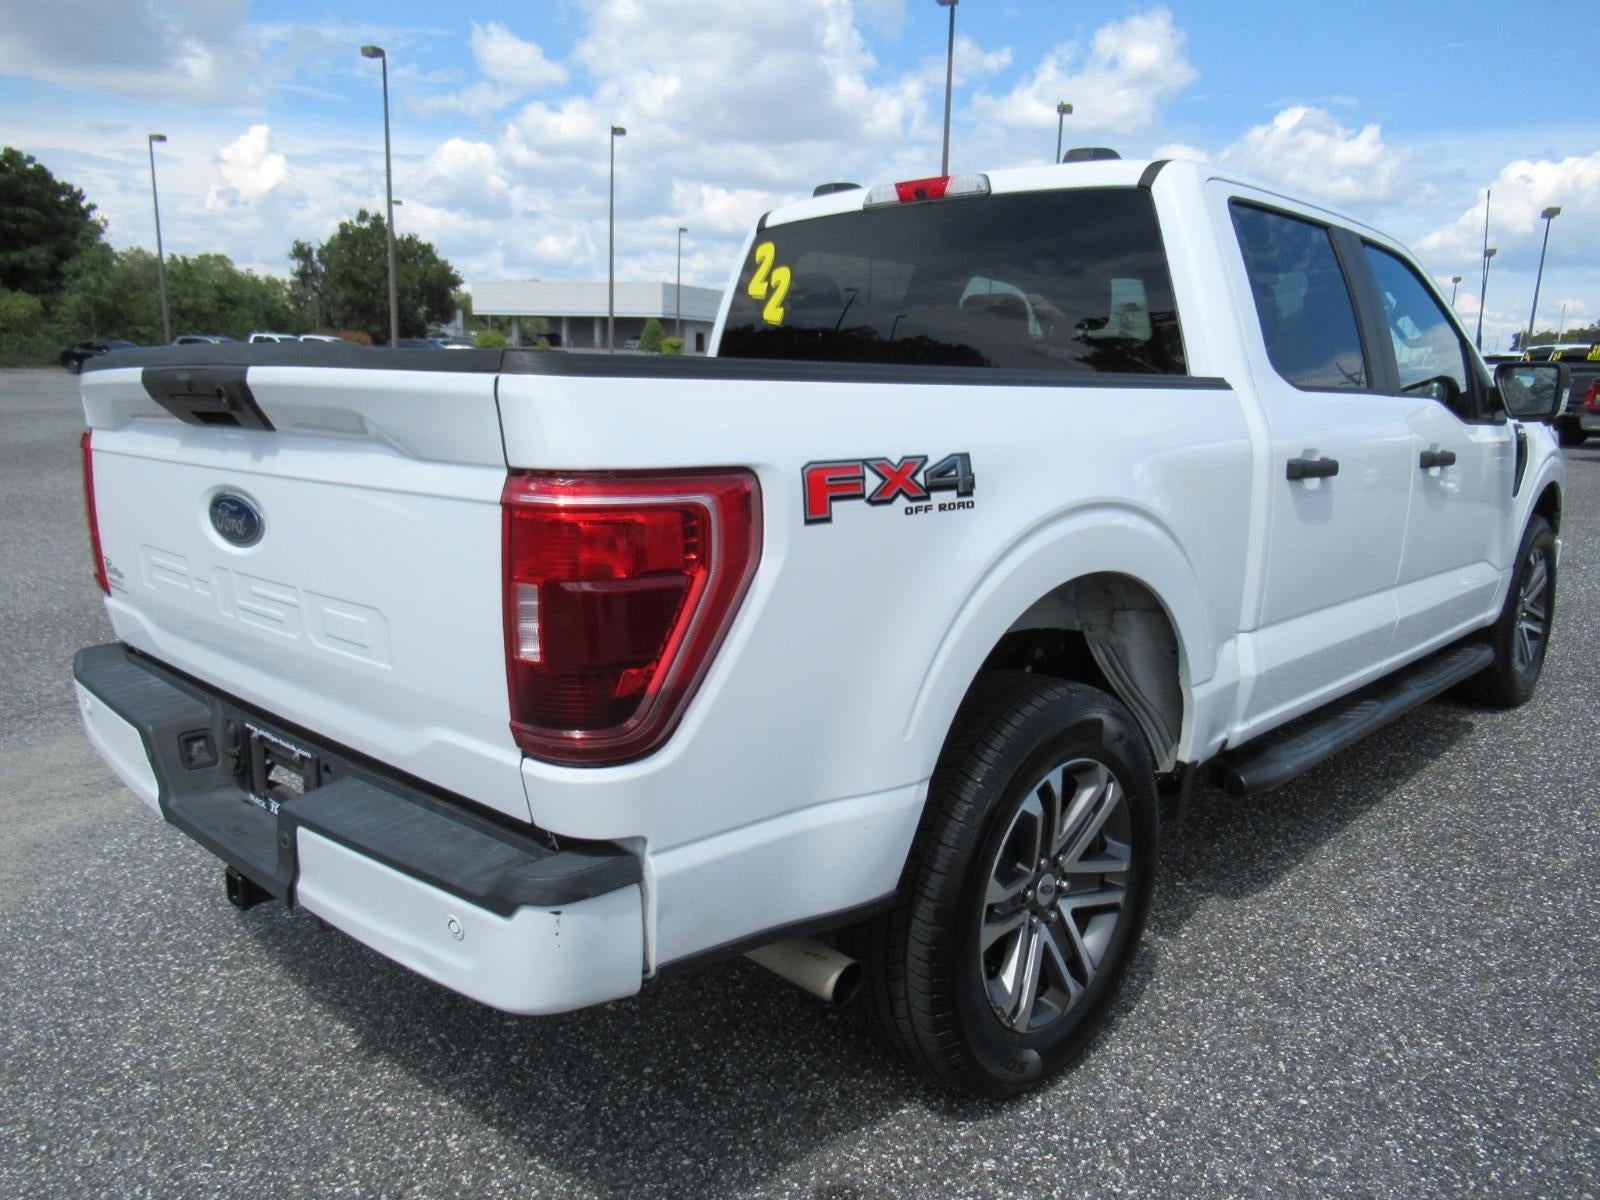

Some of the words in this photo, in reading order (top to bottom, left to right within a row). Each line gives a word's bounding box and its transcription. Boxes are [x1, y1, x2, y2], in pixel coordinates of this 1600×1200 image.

[748, 241, 791, 326] 22
[216, 501, 248, 536] Ford
[800, 452, 976, 526] FX4
[904, 503, 933, 516] OFF
[938, 500, 975, 512] ROAD
[140, 543, 392, 670] F-150
